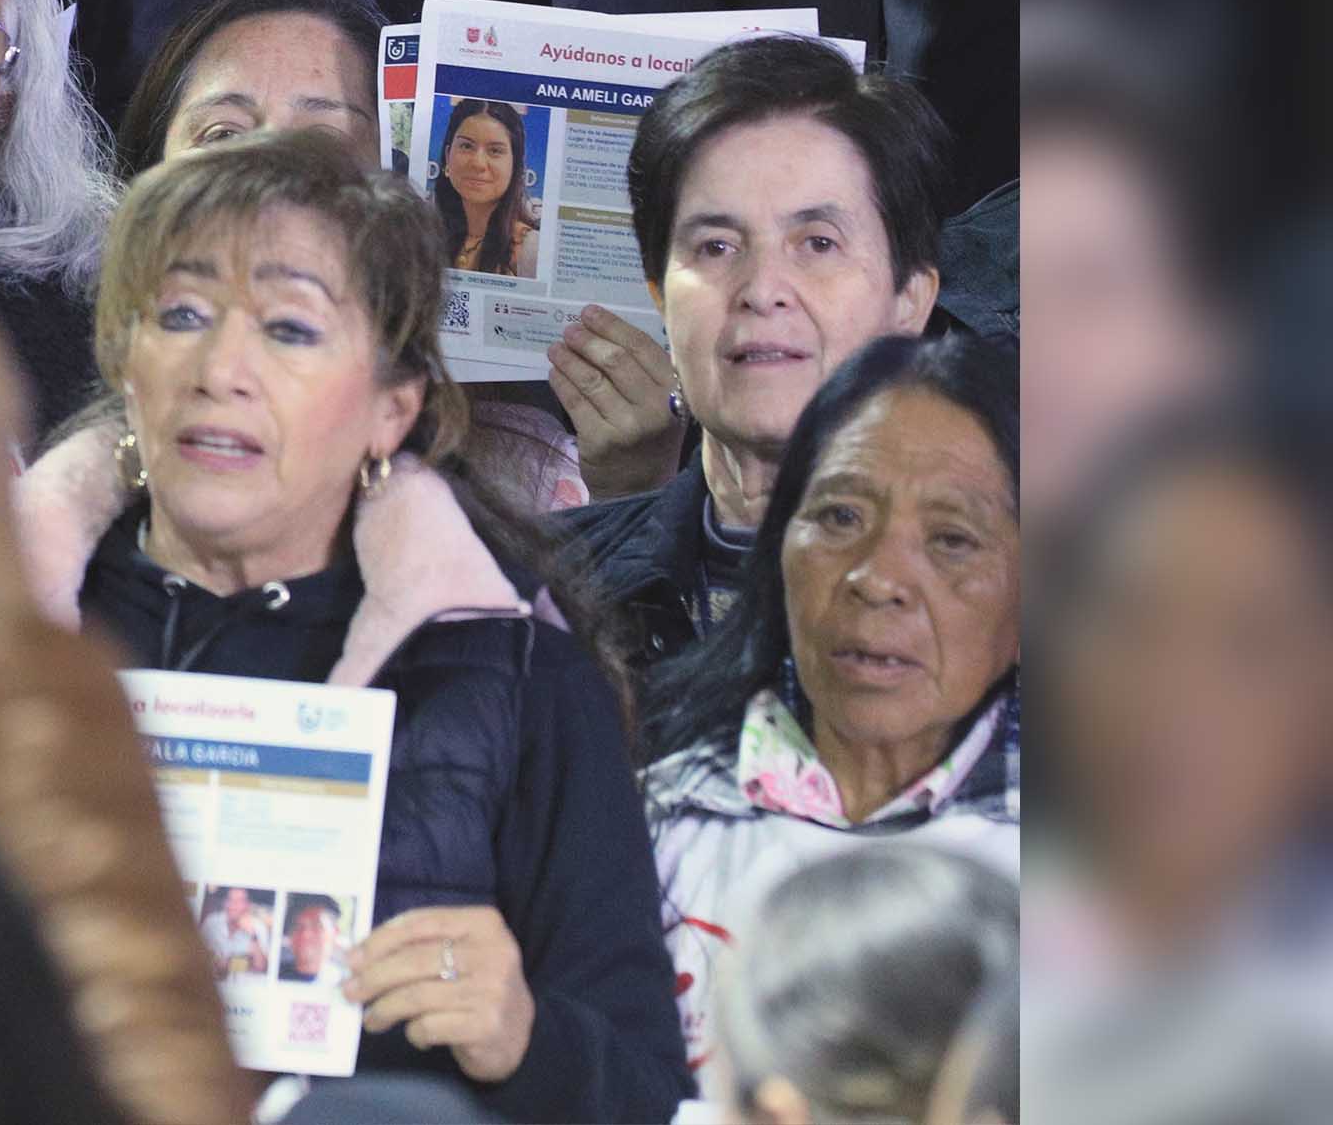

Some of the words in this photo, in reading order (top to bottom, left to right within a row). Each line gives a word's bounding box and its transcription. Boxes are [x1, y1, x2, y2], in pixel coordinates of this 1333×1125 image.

[539, 42, 626, 67] Ayúdanos
[631, 56, 643, 68] a
[647, 54, 694, 74] locali
[536, 83, 568, 100] ANA
[571, 88, 617, 105] AMELI
[621, 93, 654, 108] GAR
